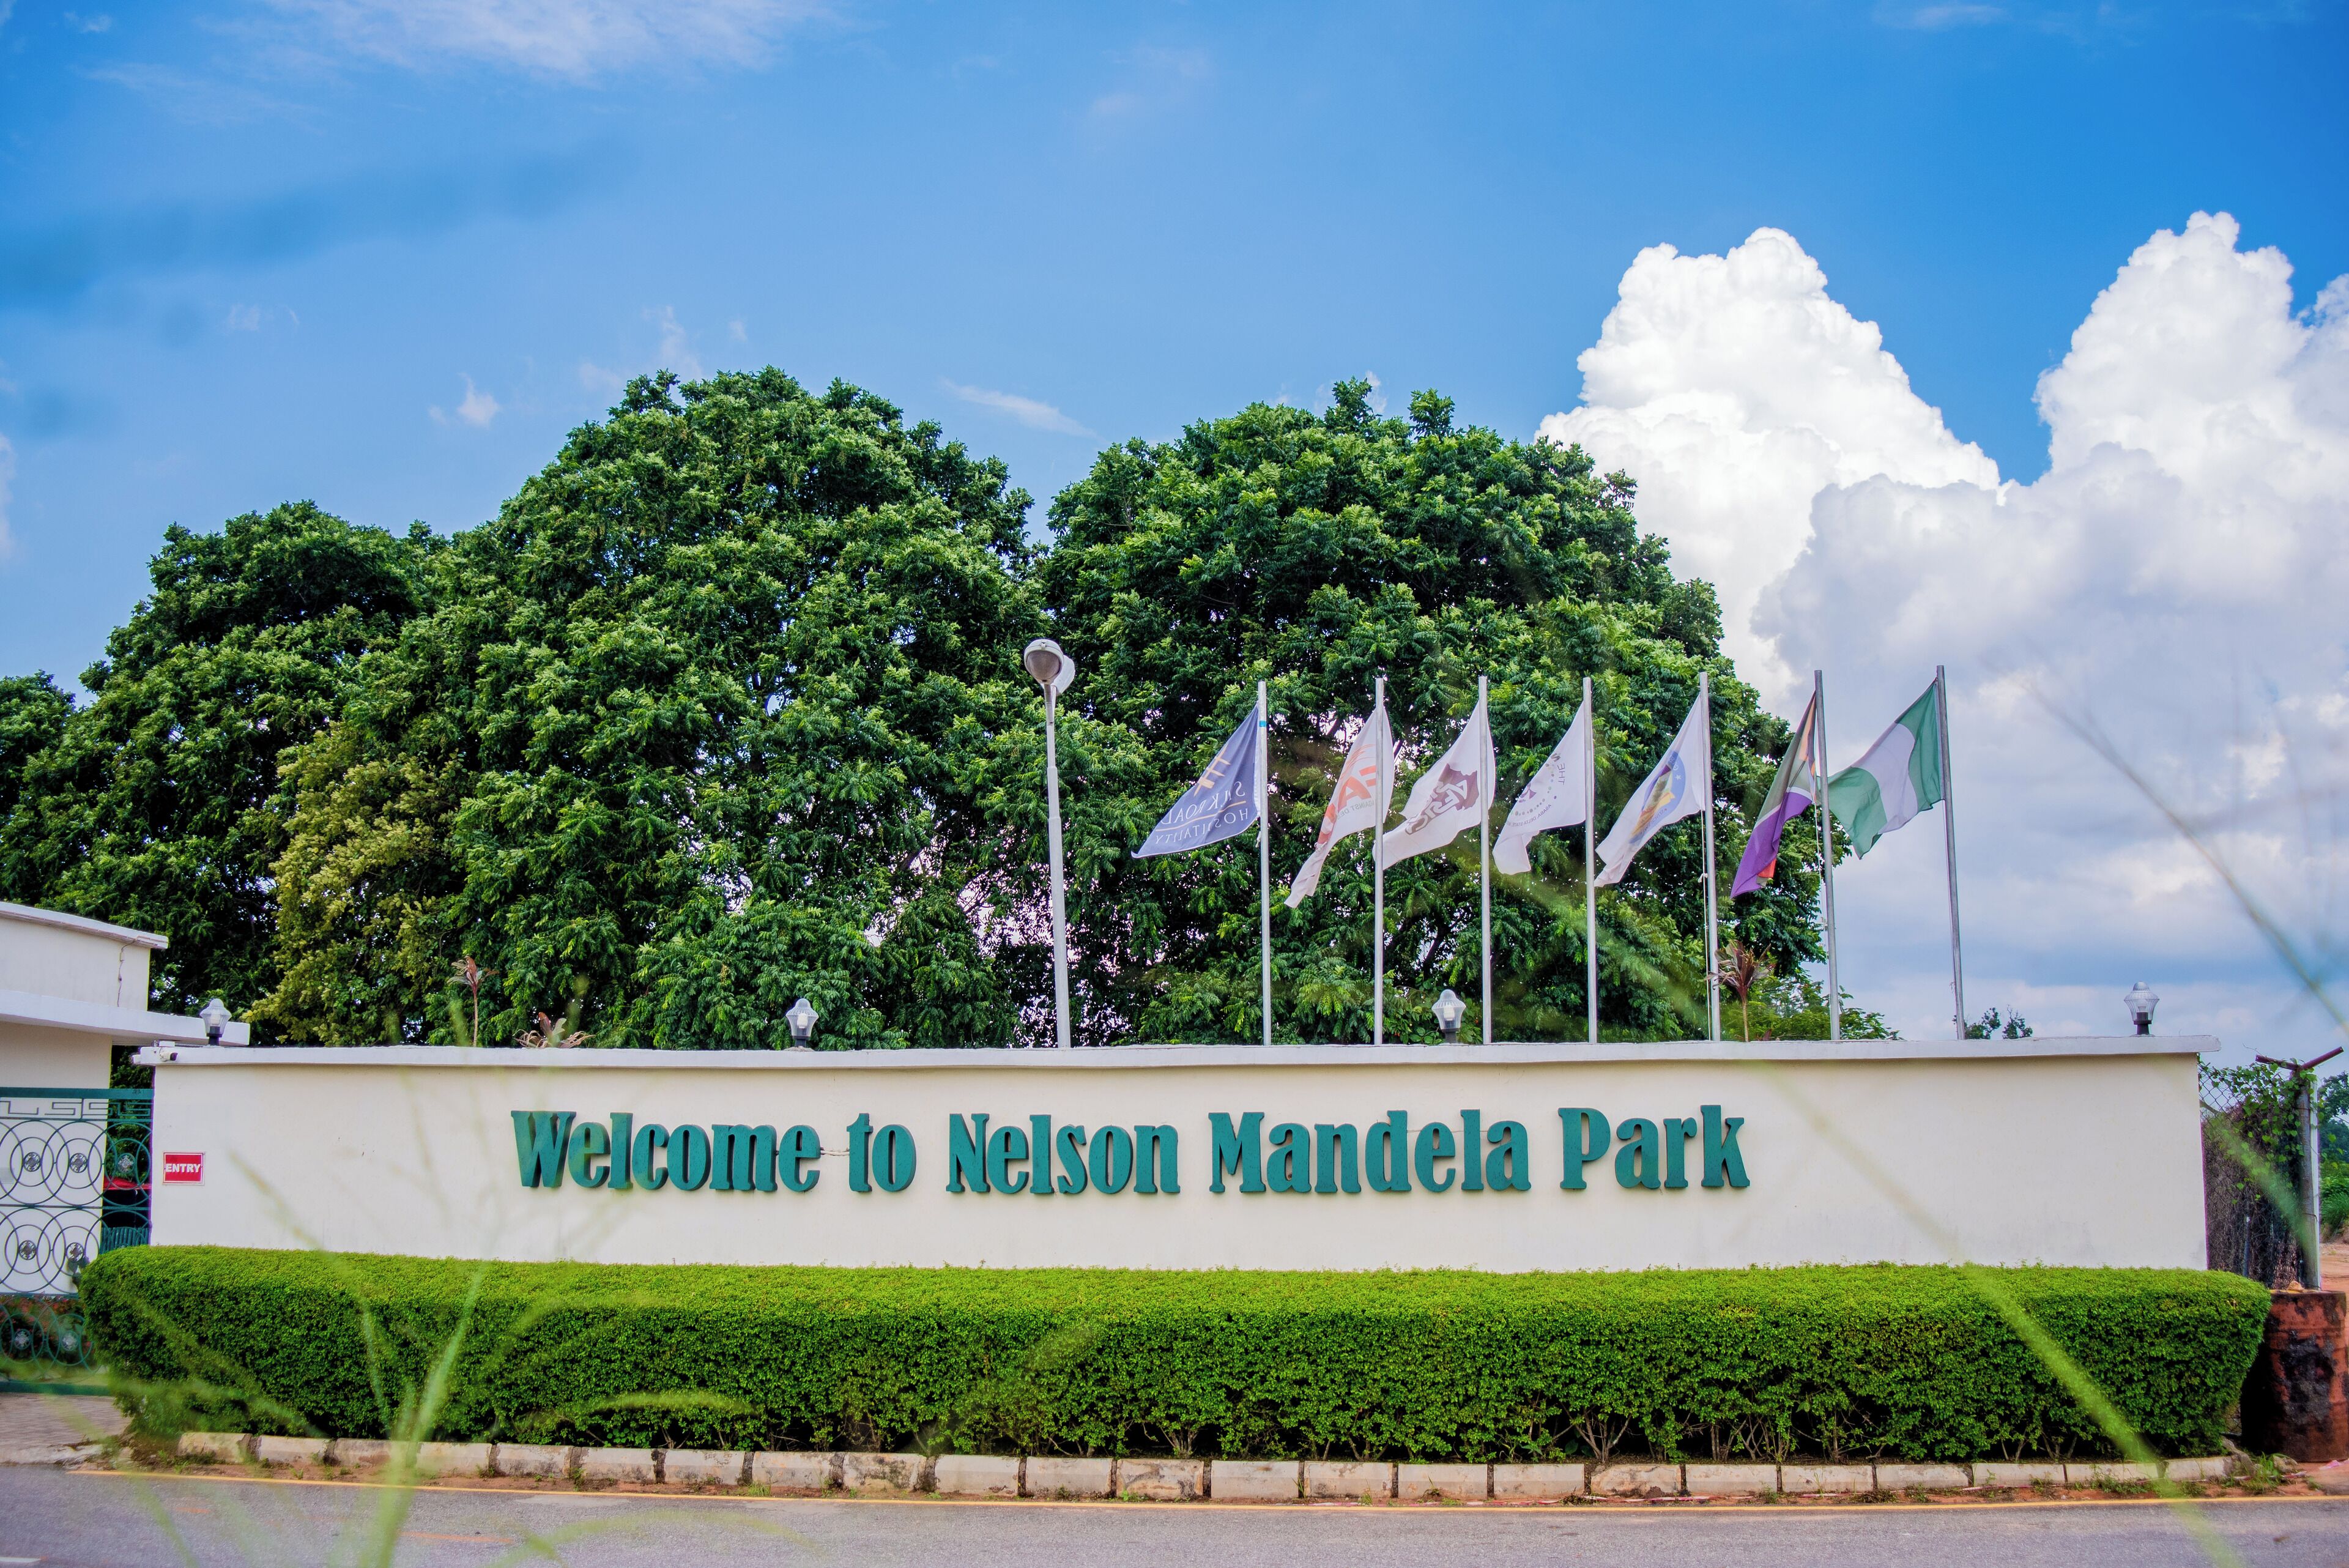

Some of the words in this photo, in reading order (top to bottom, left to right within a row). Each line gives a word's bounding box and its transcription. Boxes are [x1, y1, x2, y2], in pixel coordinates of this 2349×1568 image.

[165, 1163, 201, 1173] ENTRY
[510, 1110, 824, 1192] Welcome
[847, 1113, 916, 1192] to
[946, 1113, 1180, 1195] Nelson
[1209, 1110, 1531, 1193] Mandela
[1558, 1105, 1750, 1191] Park
